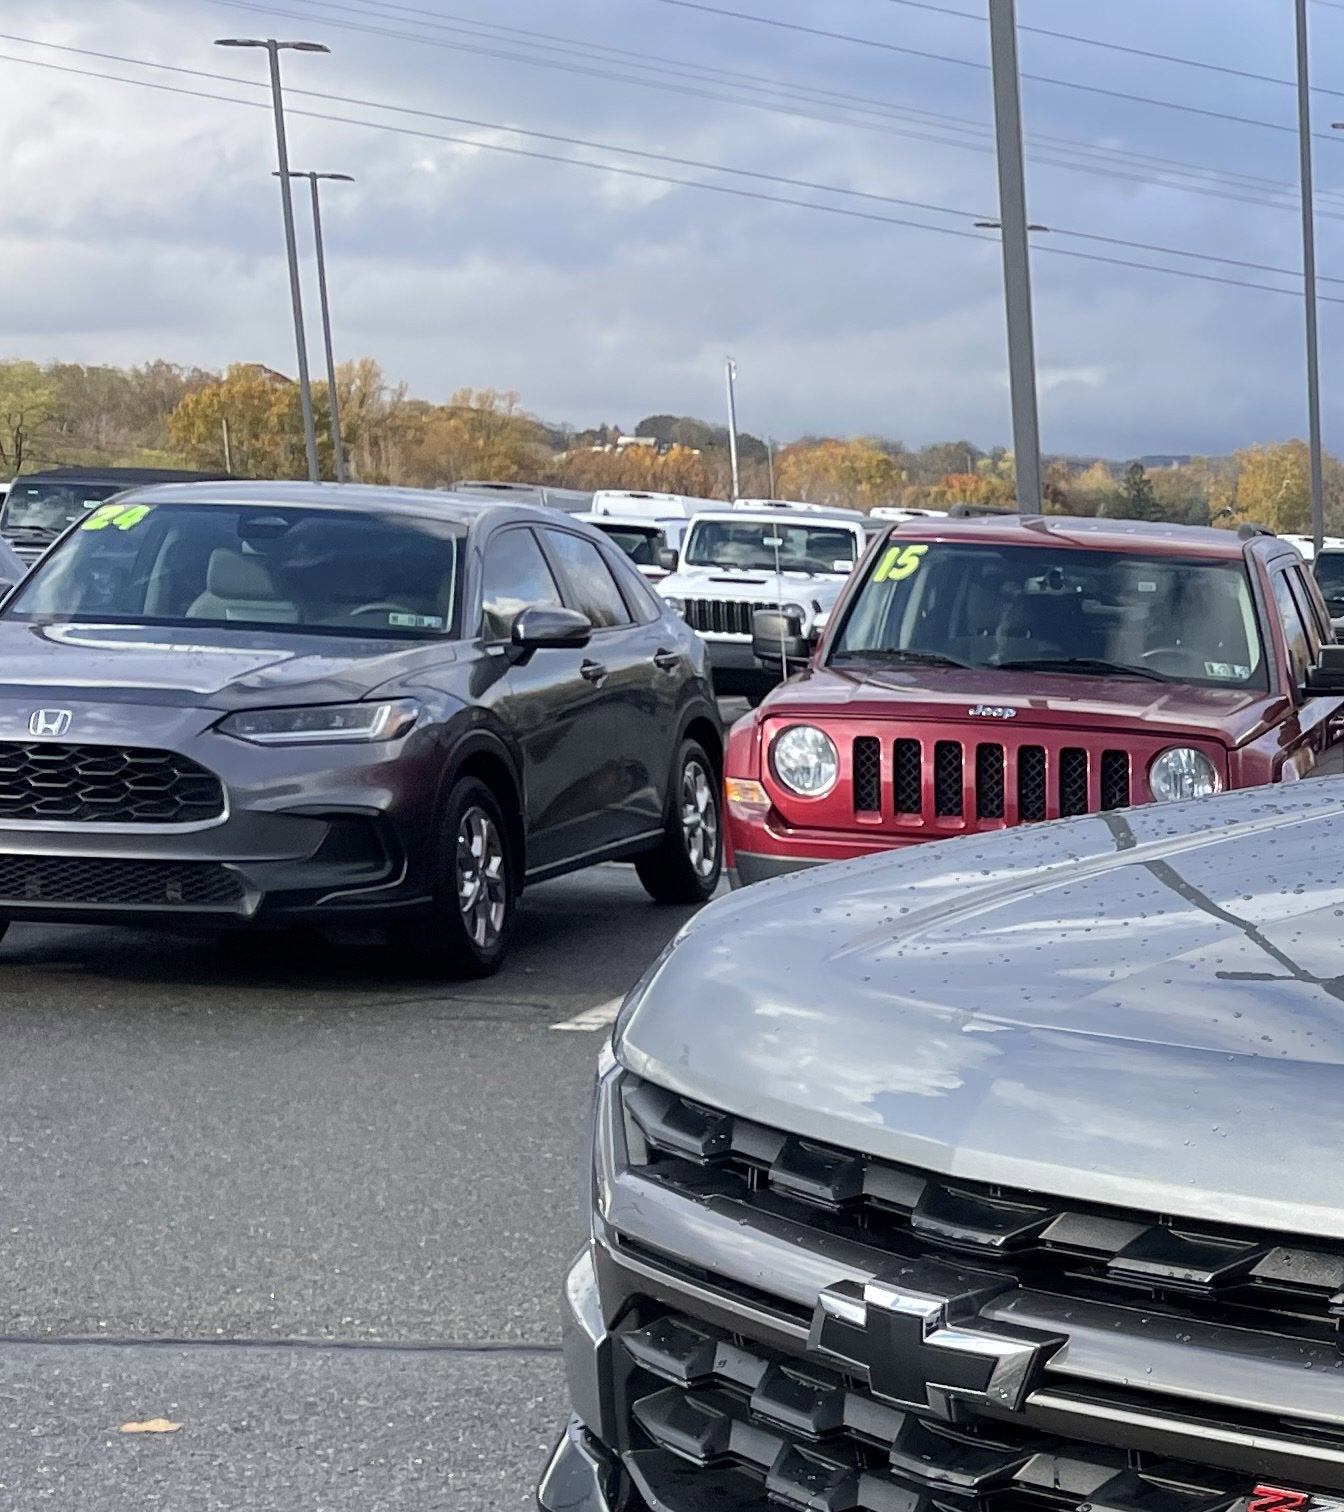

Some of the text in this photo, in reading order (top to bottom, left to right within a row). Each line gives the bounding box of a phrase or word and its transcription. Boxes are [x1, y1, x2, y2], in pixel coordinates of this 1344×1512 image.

[81, 504, 150, 531] 24
[873, 544, 929, 582] 15
[968, 704, 1017, 719] Jeep
